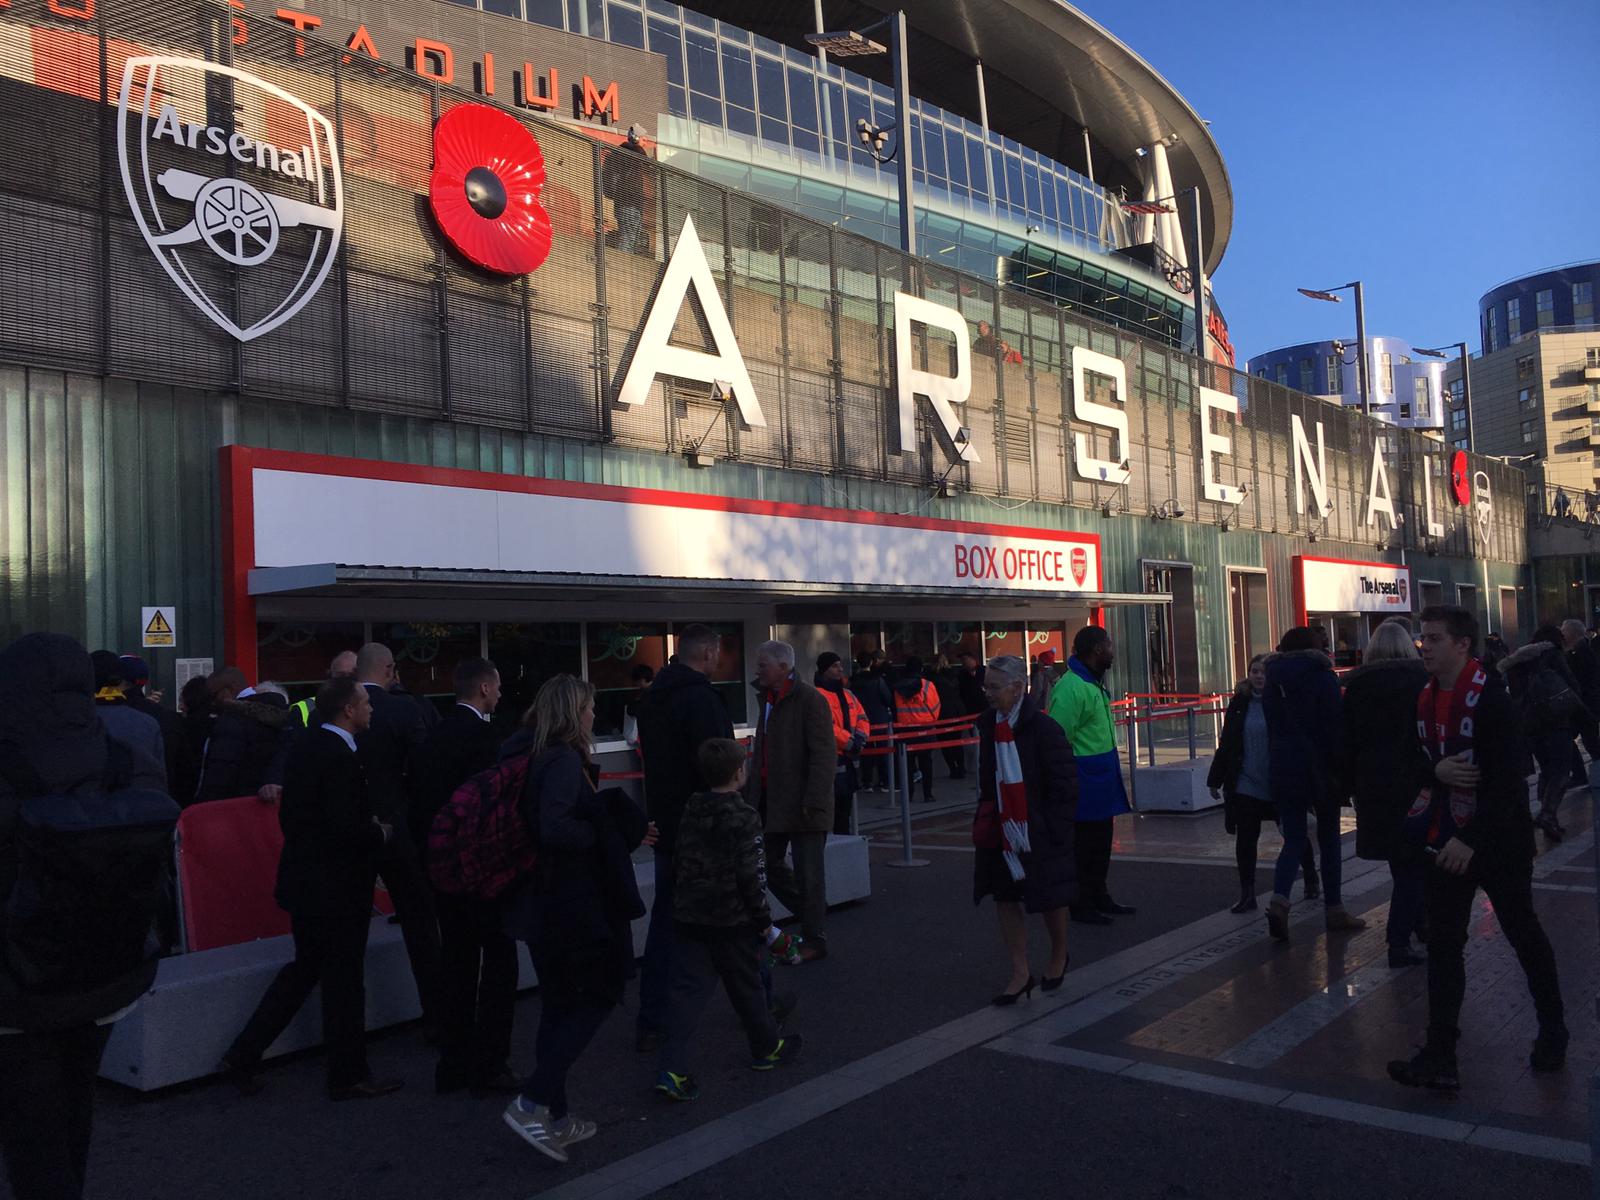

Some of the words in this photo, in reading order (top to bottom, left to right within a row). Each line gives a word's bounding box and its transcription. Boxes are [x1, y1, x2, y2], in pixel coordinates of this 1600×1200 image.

[151, 104, 315, 182] Arsenal
[617, 212, 1445, 538] ARSENAL
[954, 543, 999, 579] BOX
[1003, 547, 1065, 582] OFFICE
[1360, 576, 1374, 594] The
[1374, 577, 1400, 596] Arsenal
[1115, 970, 1176, 998] CLUB
